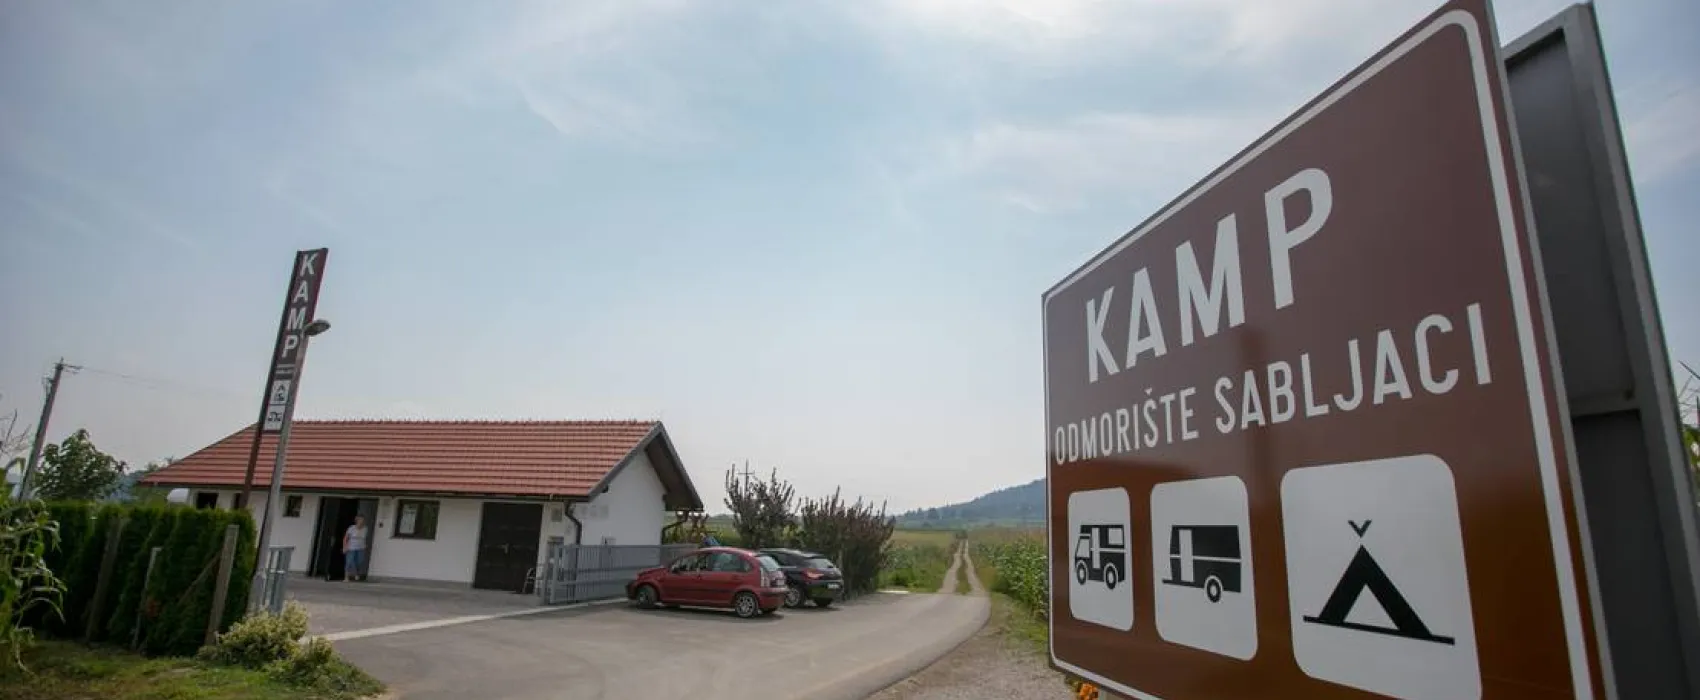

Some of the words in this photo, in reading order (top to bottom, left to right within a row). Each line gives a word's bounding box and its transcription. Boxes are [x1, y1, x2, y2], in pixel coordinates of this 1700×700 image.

[283, 254, 317, 358] KAMP
[1086, 168, 1333, 383] KAMP
[1055, 387, 1199, 465] ODMORIŠTE
[1215, 303, 1492, 434] SABLJACI
